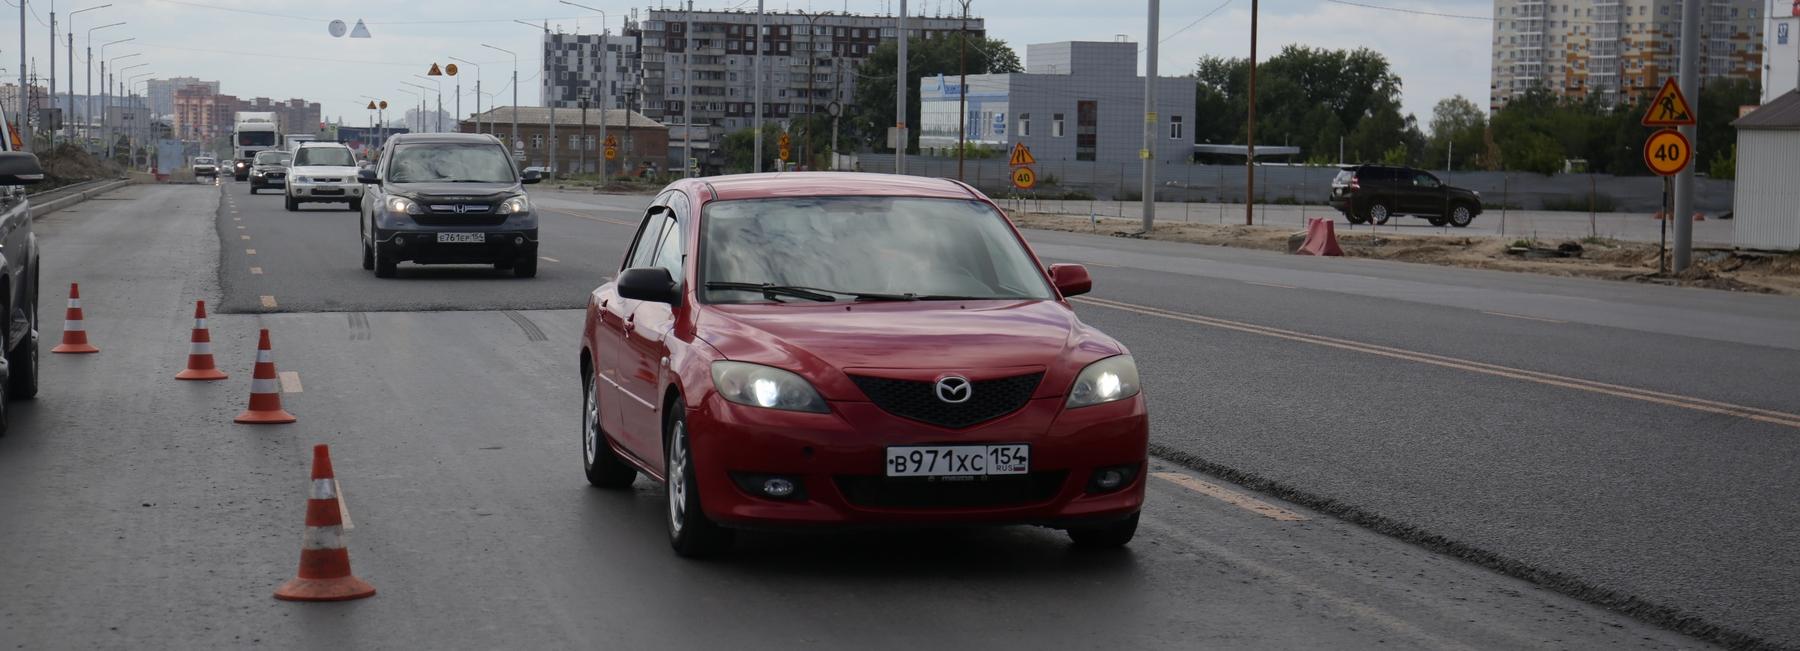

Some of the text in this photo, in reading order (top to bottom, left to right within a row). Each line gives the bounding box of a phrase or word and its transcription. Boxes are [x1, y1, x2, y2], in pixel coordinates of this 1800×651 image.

[1654, 143, 1680, 161] 40
[1017, 173, 1030, 183] 40
[989, 447, 1023, 465] 154
[996, 464, 1013, 472] RUS
